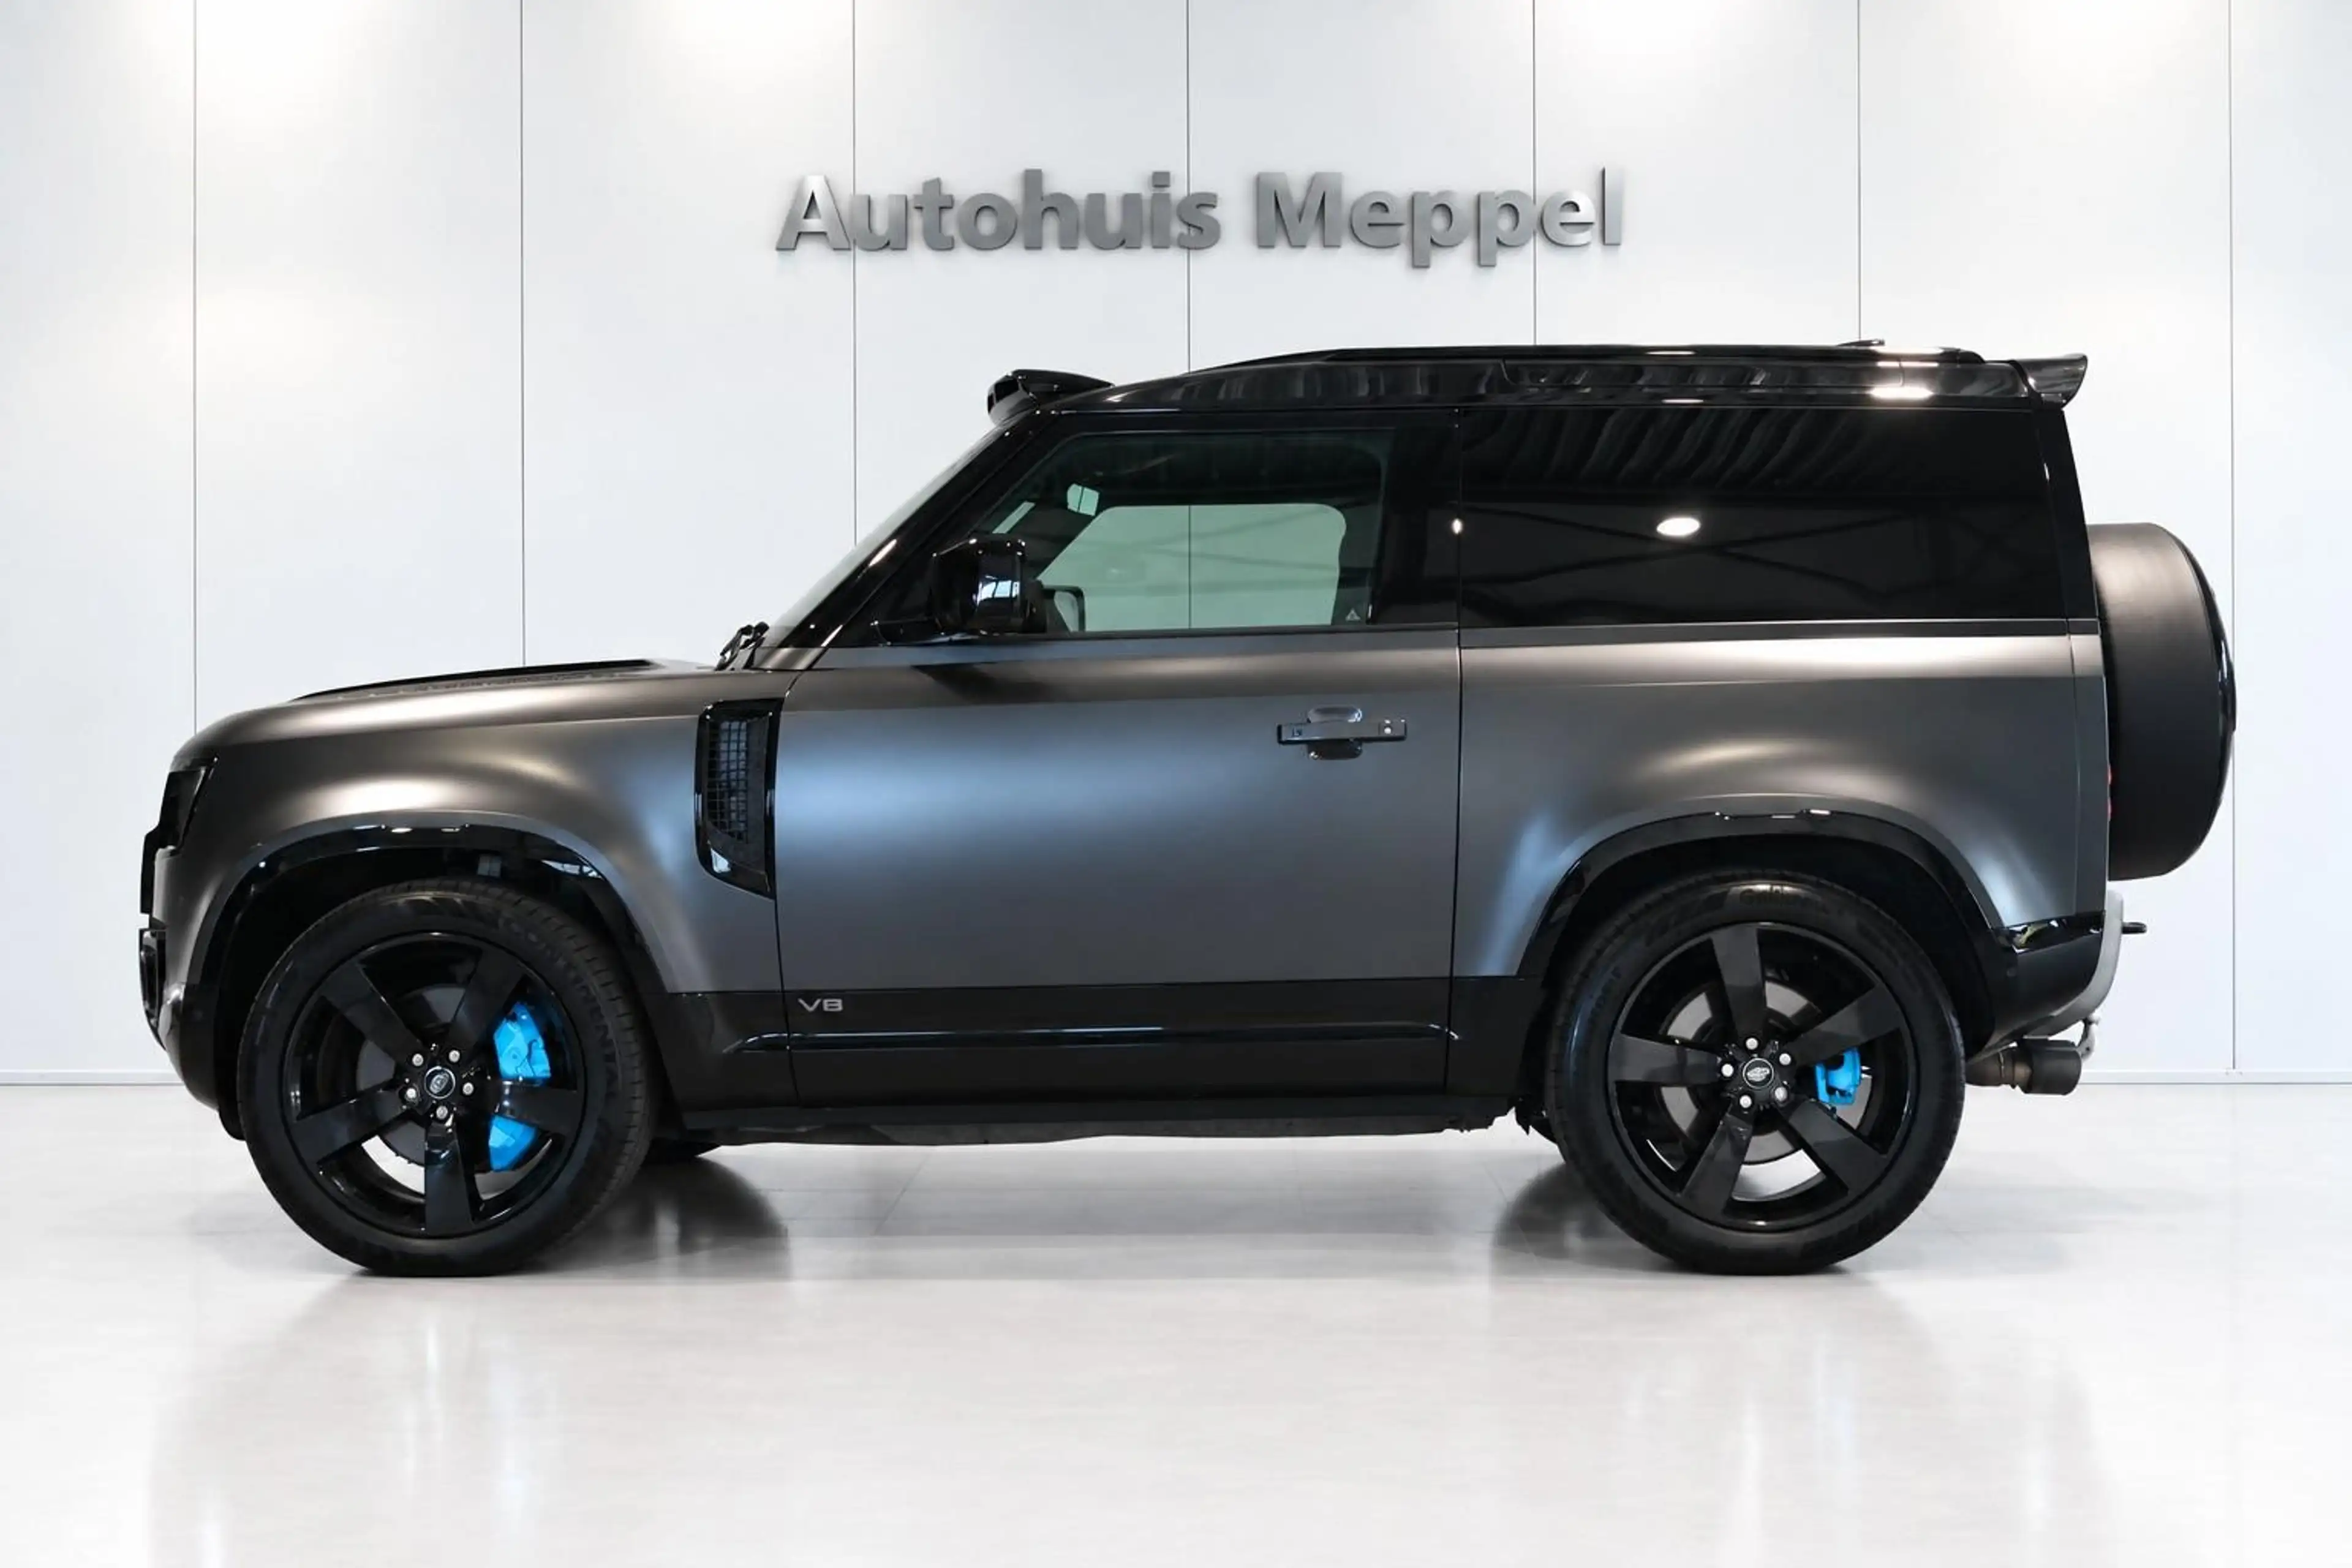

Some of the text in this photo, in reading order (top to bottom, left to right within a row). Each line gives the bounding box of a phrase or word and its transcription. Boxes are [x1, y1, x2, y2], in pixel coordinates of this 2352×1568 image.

[775, 167, 1624, 268] Autohuis Meppel
[797, 998, 843, 1012] V8
